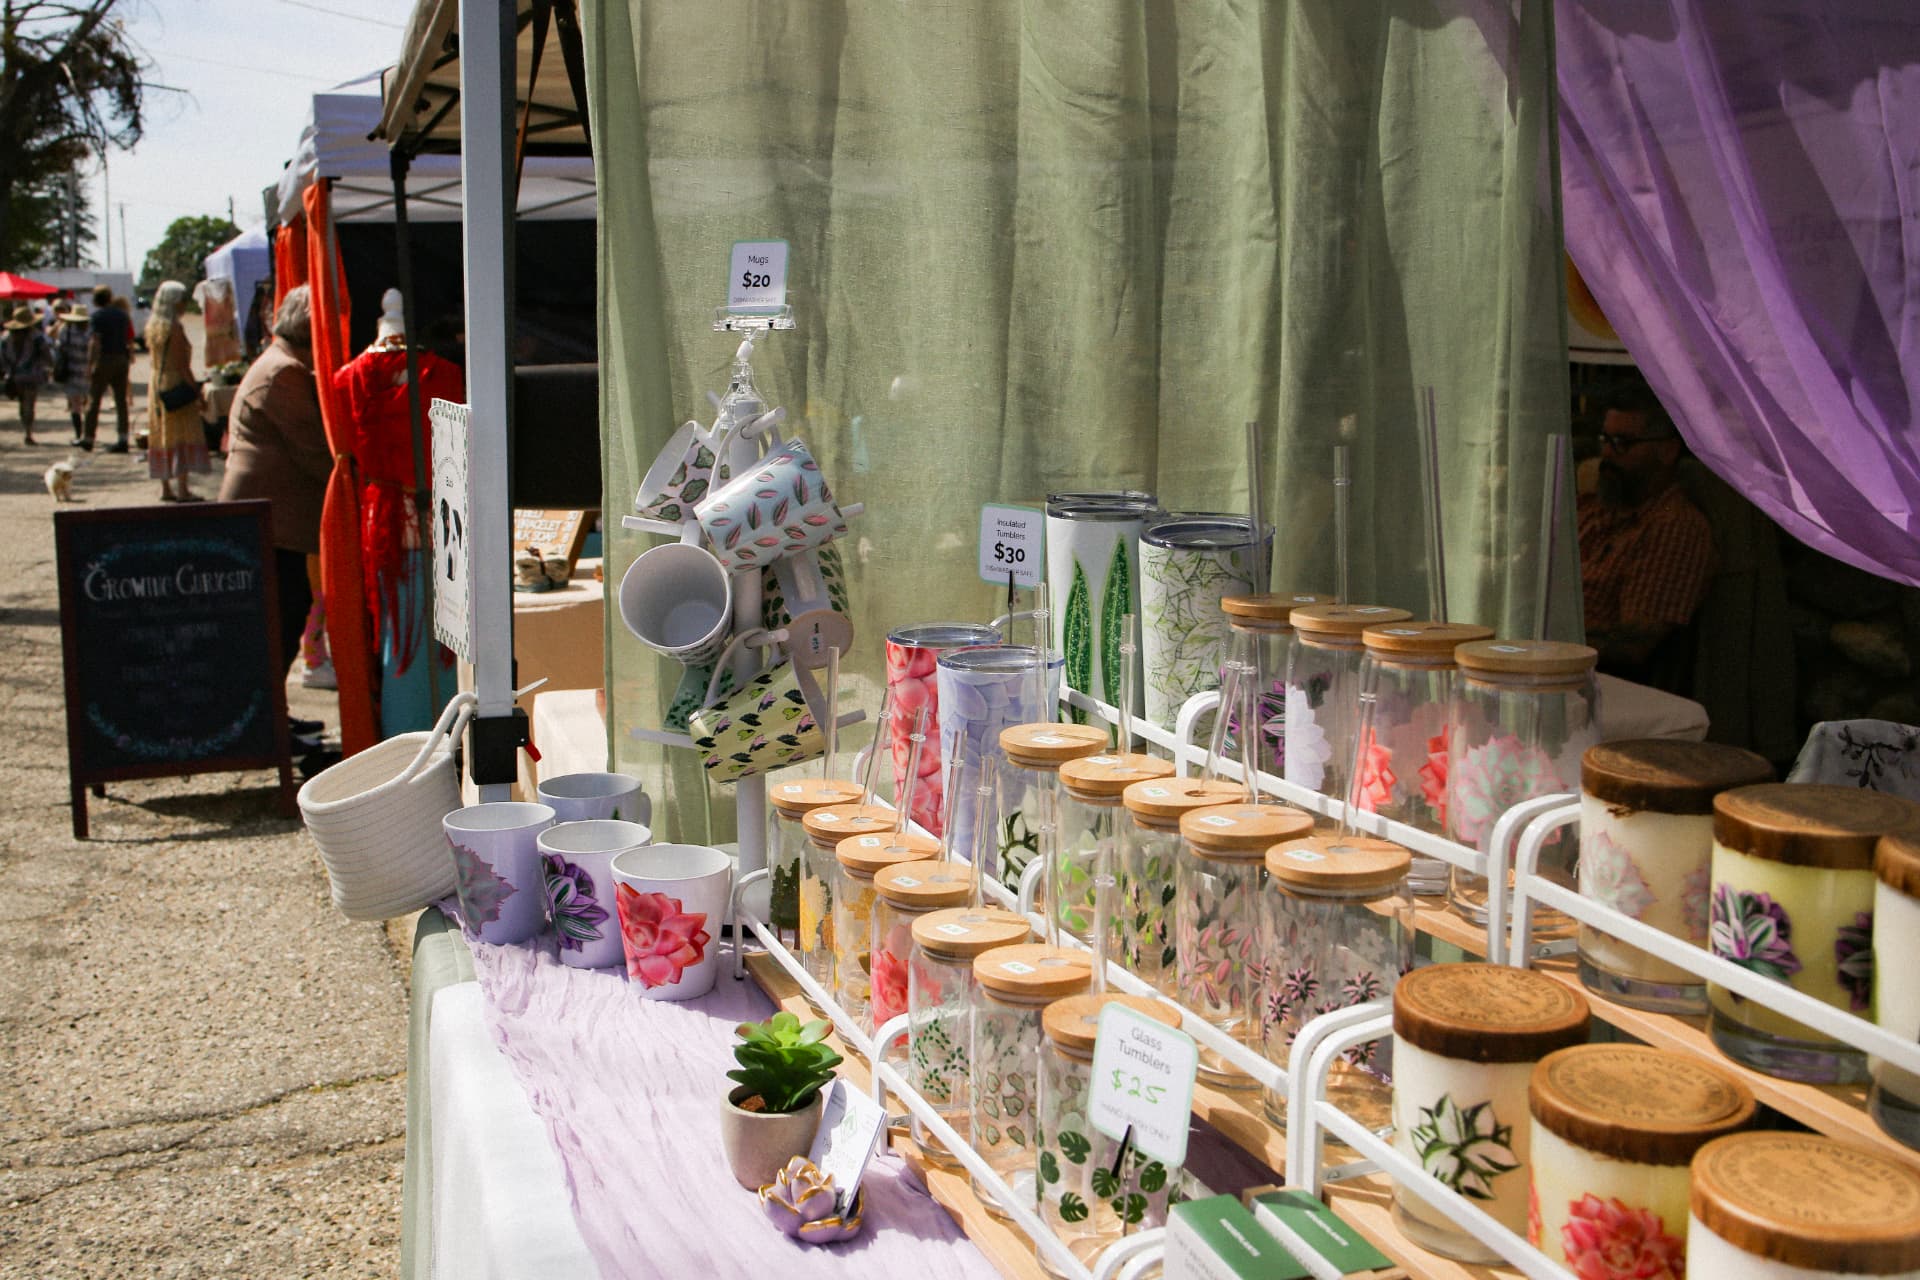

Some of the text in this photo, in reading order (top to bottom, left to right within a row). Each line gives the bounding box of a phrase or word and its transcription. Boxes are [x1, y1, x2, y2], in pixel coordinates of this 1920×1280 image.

[747, 255, 769, 266] Mugs
[742, 269, 771, 290] $20
[997, 517, 1026, 529] Insulated
[995, 529, 1026, 541] Tumblers
[994, 540, 1026, 564] $30
[1131, 1026, 1163, 1051] Glass
[1118, 1038, 1172, 1075] Tumblers
[1112, 1067, 1167, 1104] $25
